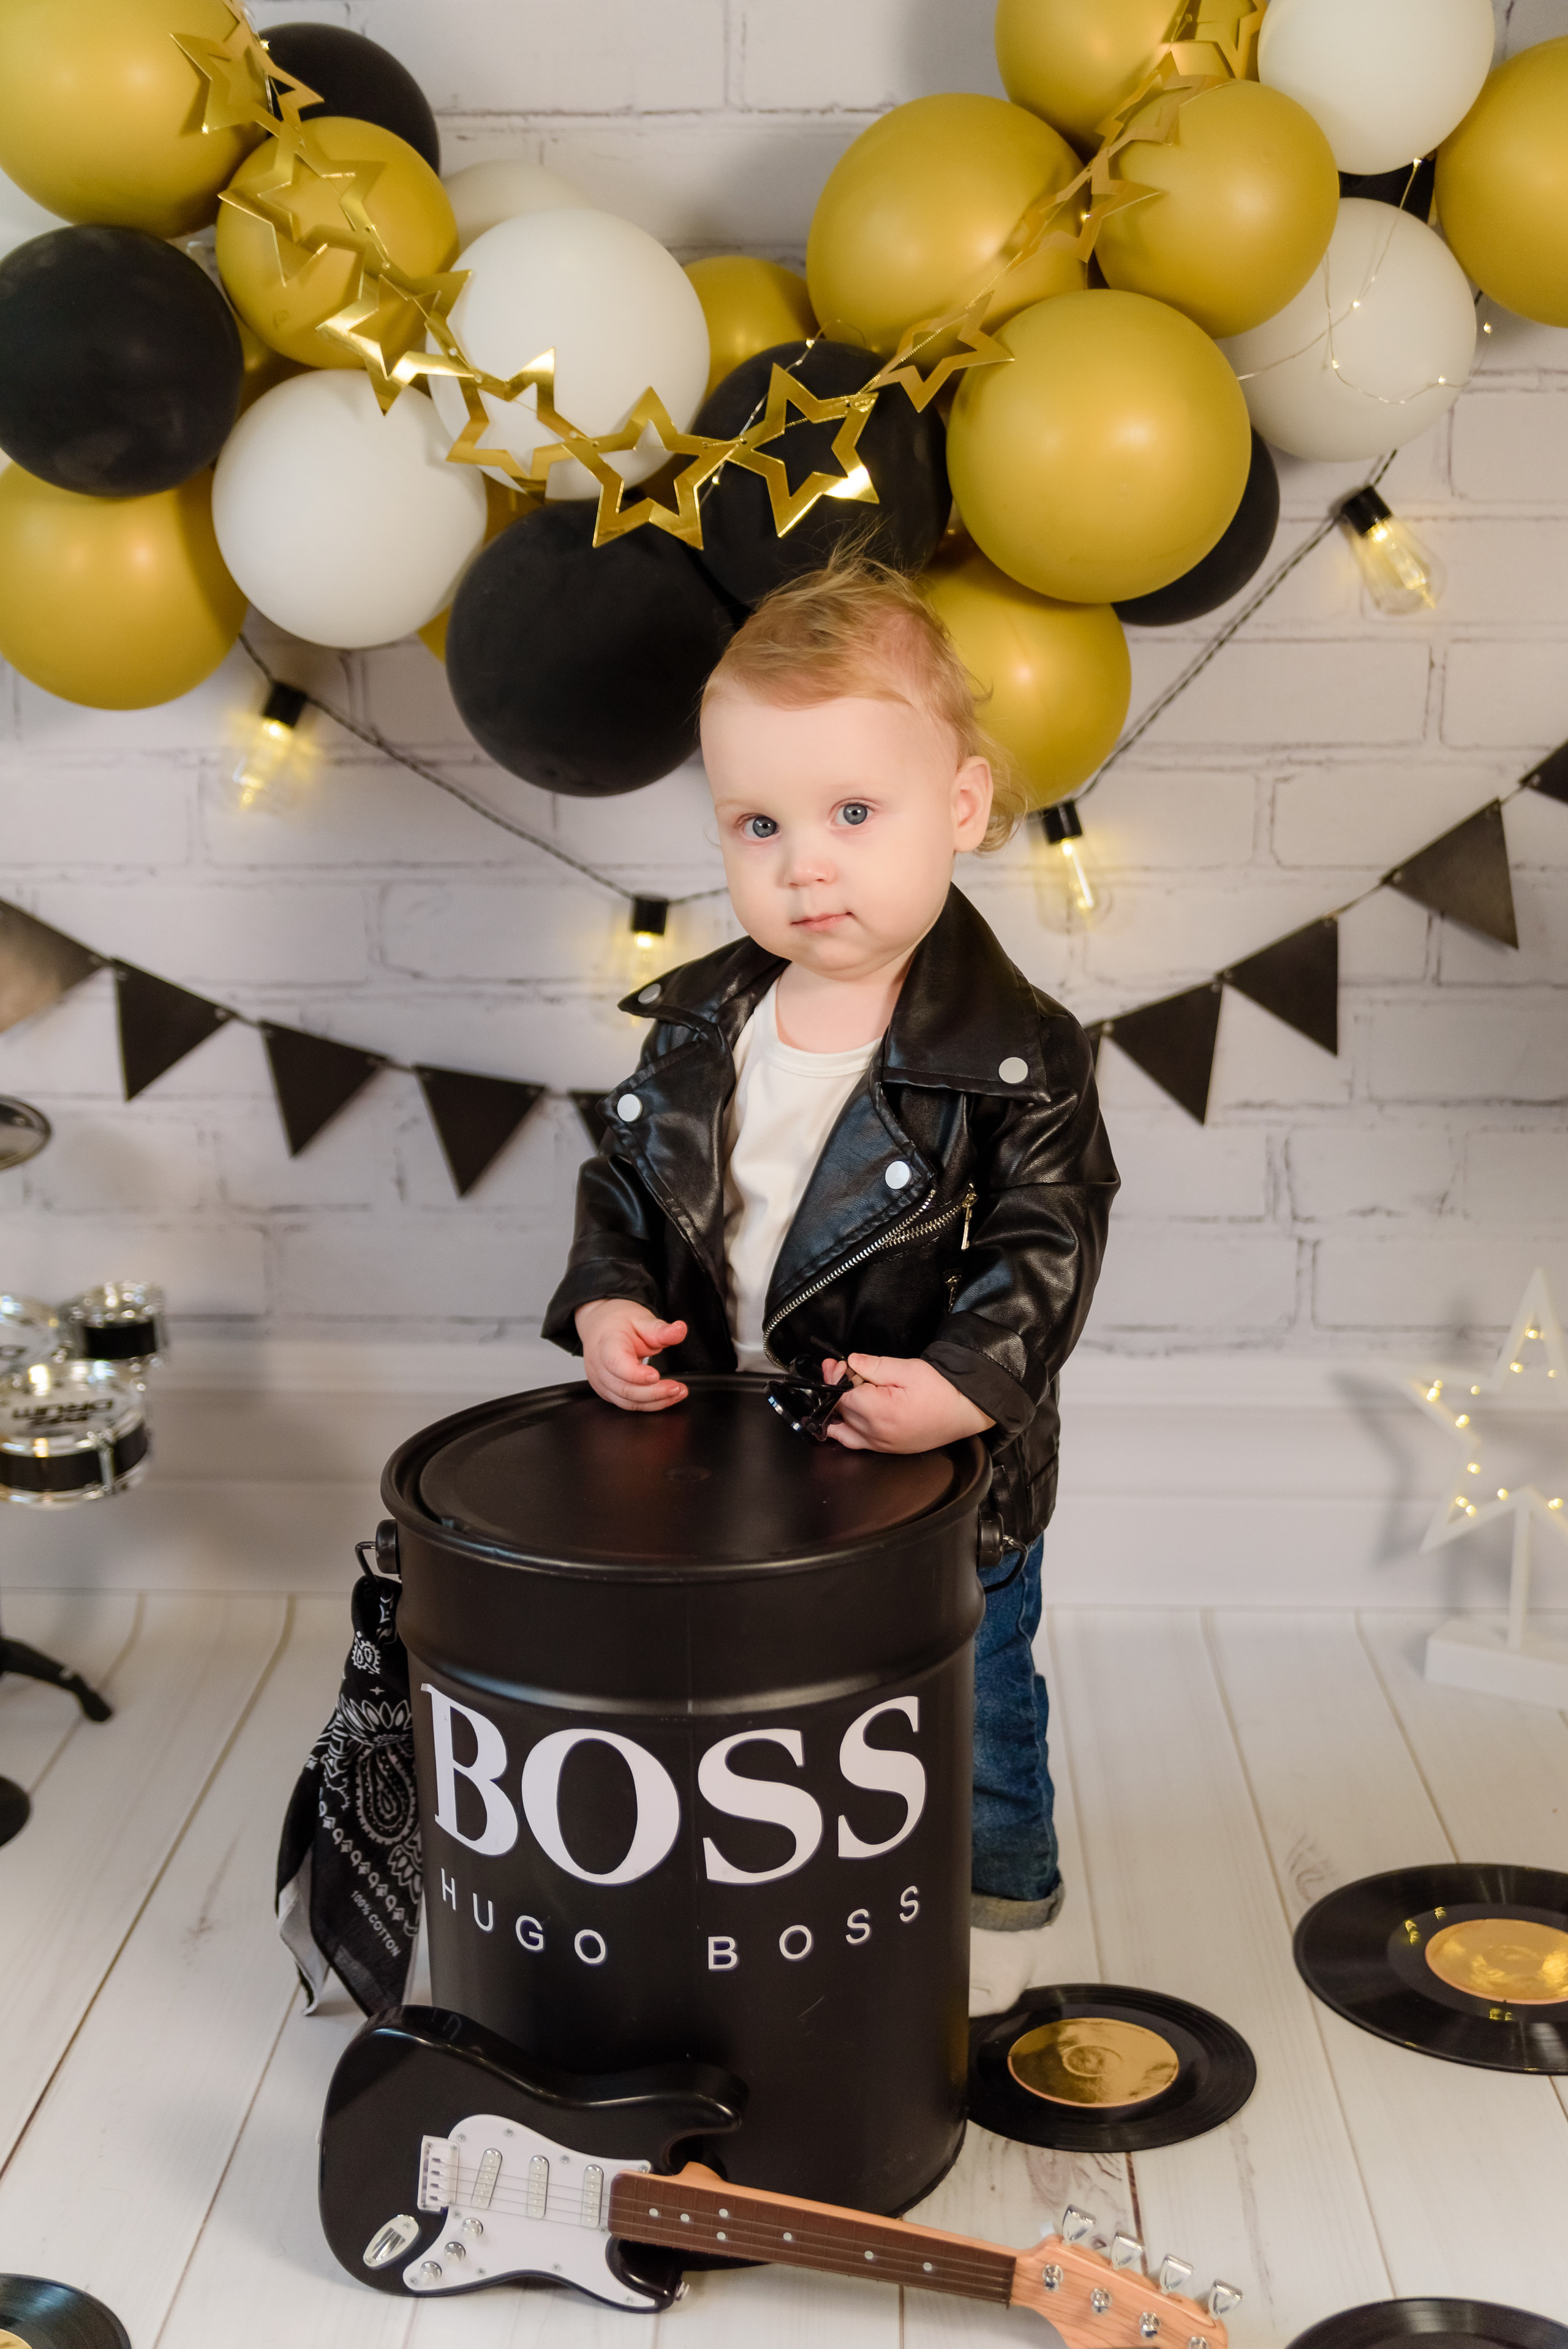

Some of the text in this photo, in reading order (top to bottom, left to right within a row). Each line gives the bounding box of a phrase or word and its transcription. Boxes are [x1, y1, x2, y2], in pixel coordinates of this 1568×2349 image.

[420, 1683, 926, 1885] BOSS
[351, 1891, 401, 1957] 100% COTTON
[441, 1867, 919, 1970] HUGO BOSS
